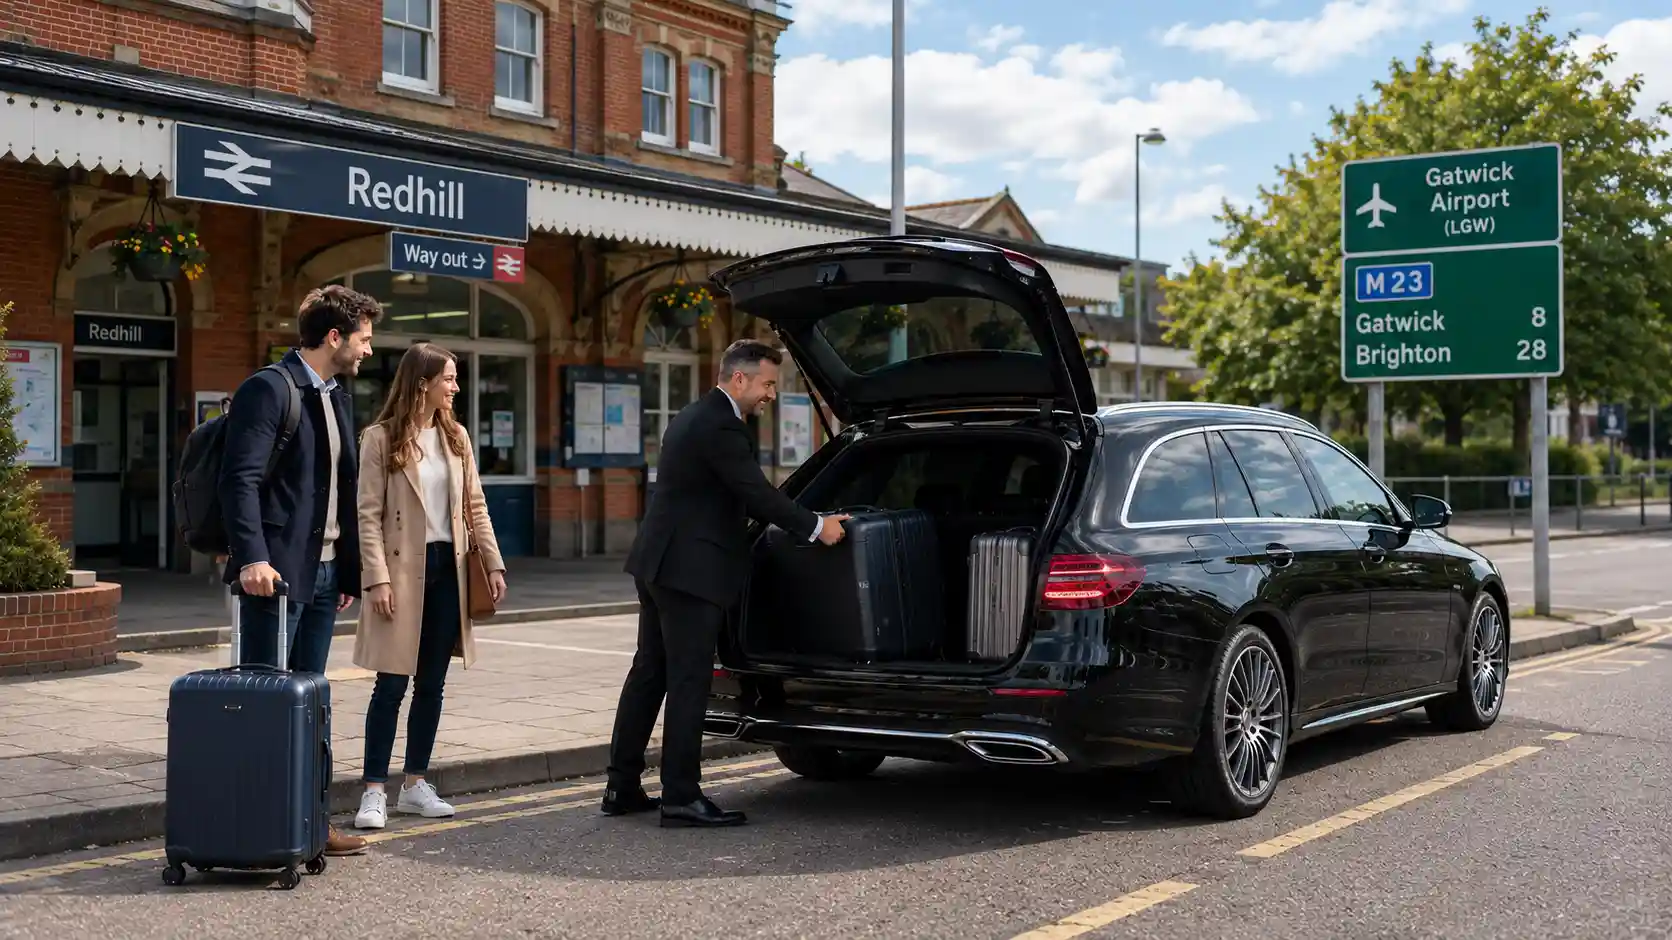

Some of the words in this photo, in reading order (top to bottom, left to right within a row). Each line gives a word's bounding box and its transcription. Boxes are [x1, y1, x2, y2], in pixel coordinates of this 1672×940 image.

[1425, 161, 1514, 187] Gatwick
[348, 166, 464, 220] Redhill
[1430, 188, 1510, 214] Airport
[1444, 216, 1495, 237] (LGW)
[404, 243, 439, 269] Way
[441, 250, 468, 269] out
[88, 323, 142, 342] Redhill
[1356, 310, 1445, 334] Gatwick
[1531, 306, 1546, 328] 8
[1356, 343, 1451, 369] Brighton
[1516, 339, 1547, 361] 28
